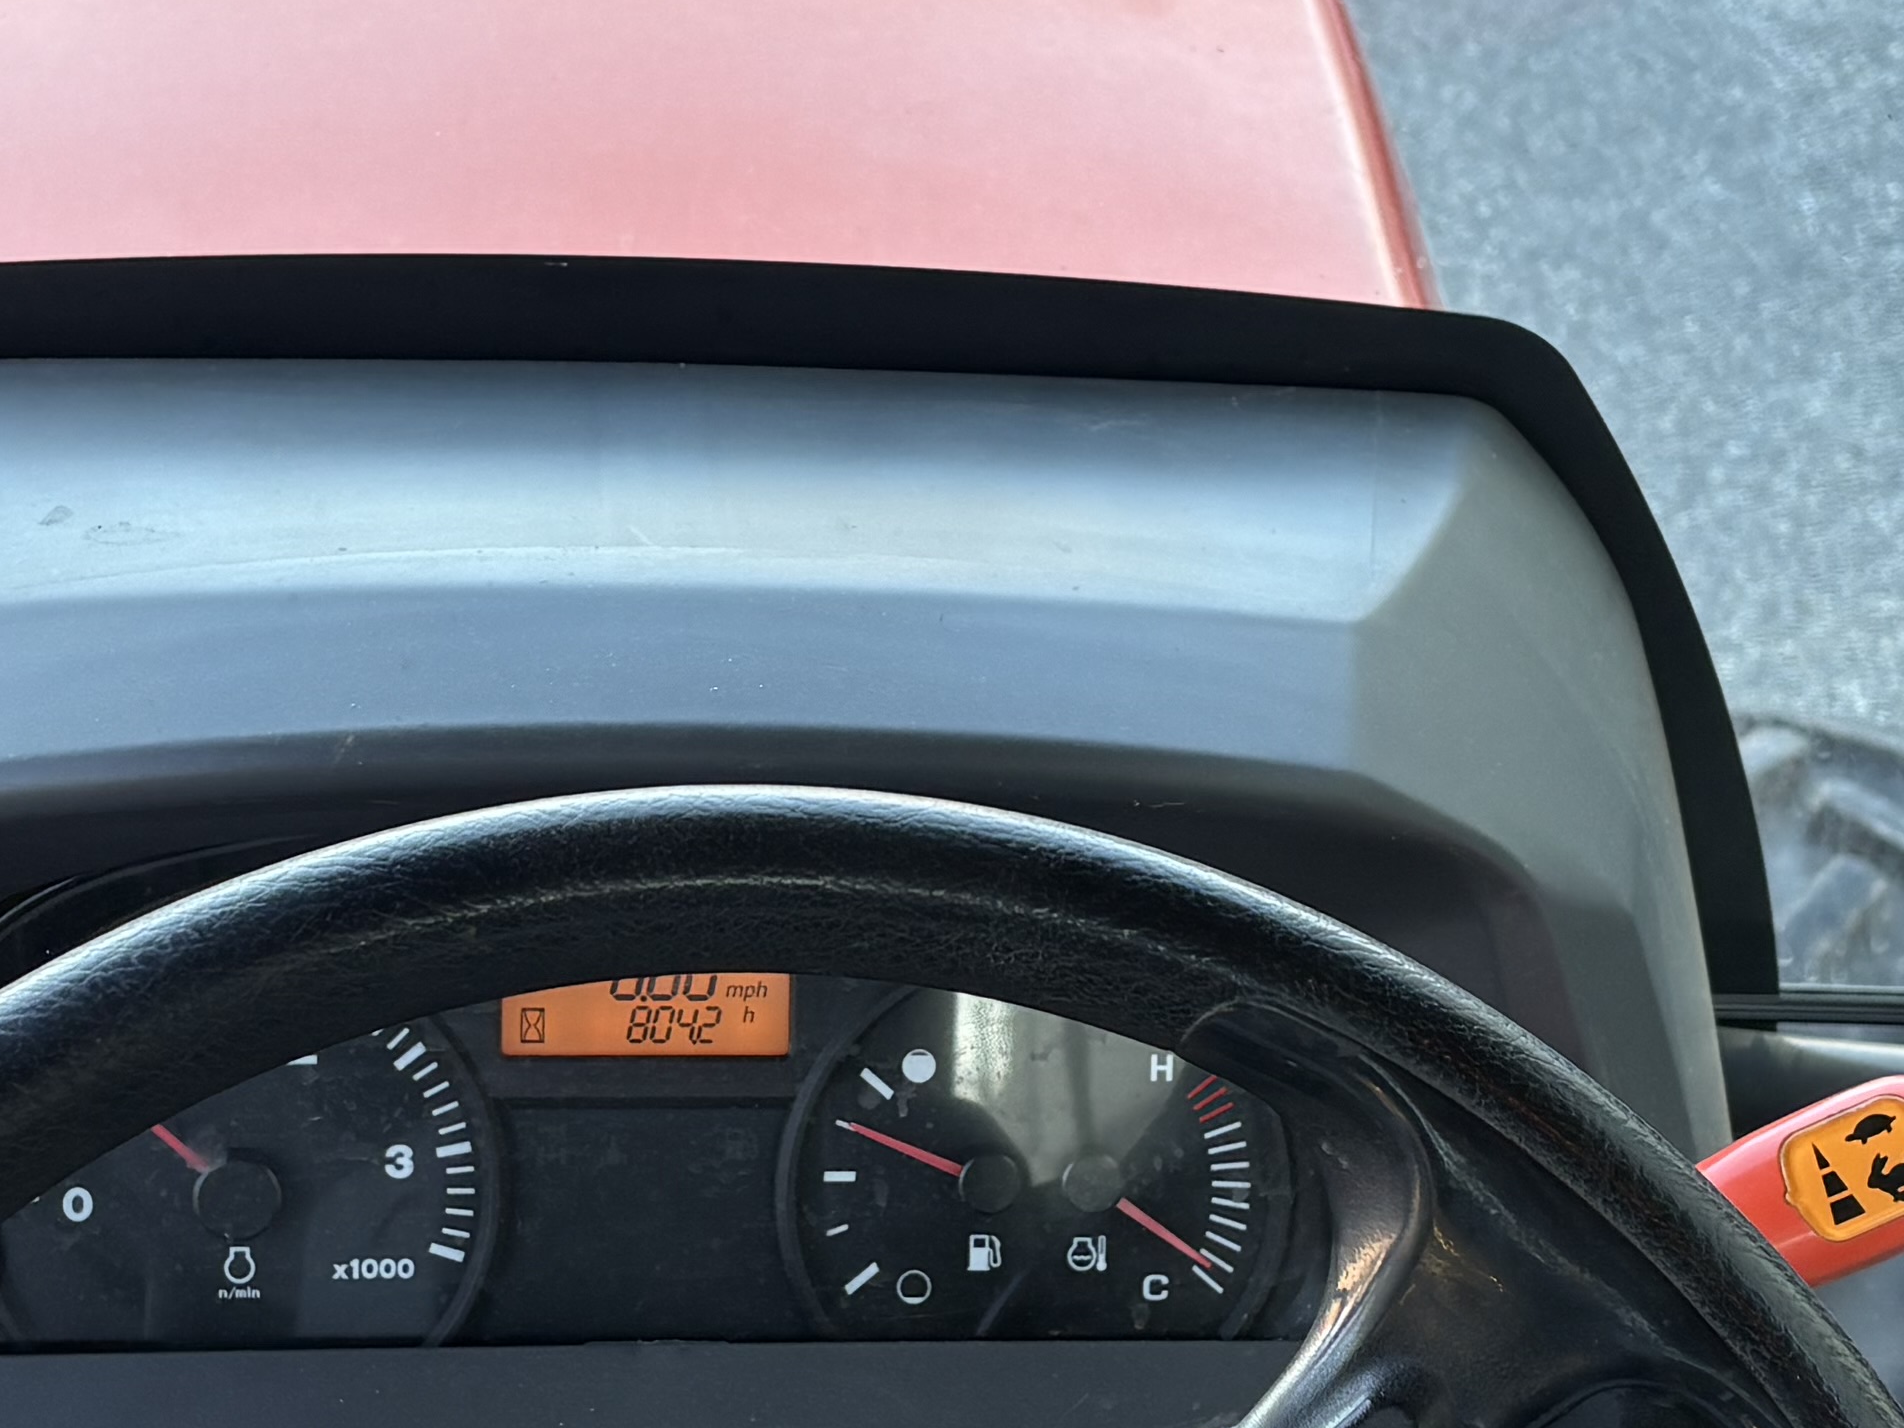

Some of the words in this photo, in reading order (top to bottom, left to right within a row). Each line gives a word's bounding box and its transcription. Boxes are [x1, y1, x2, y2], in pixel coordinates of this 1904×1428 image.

[725, 980, 769, 1002] mph
[742, 1006, 756, 1024] h
[1151, 1054, 1174, 1082] H
[384, 1143, 415, 1179] 3
[62, 1186, 94, 1223] 0
[331, 1258, 415, 1281] x1000
[217, 1286, 261, 1301] n/min
[1142, 1274, 1170, 1302] C
